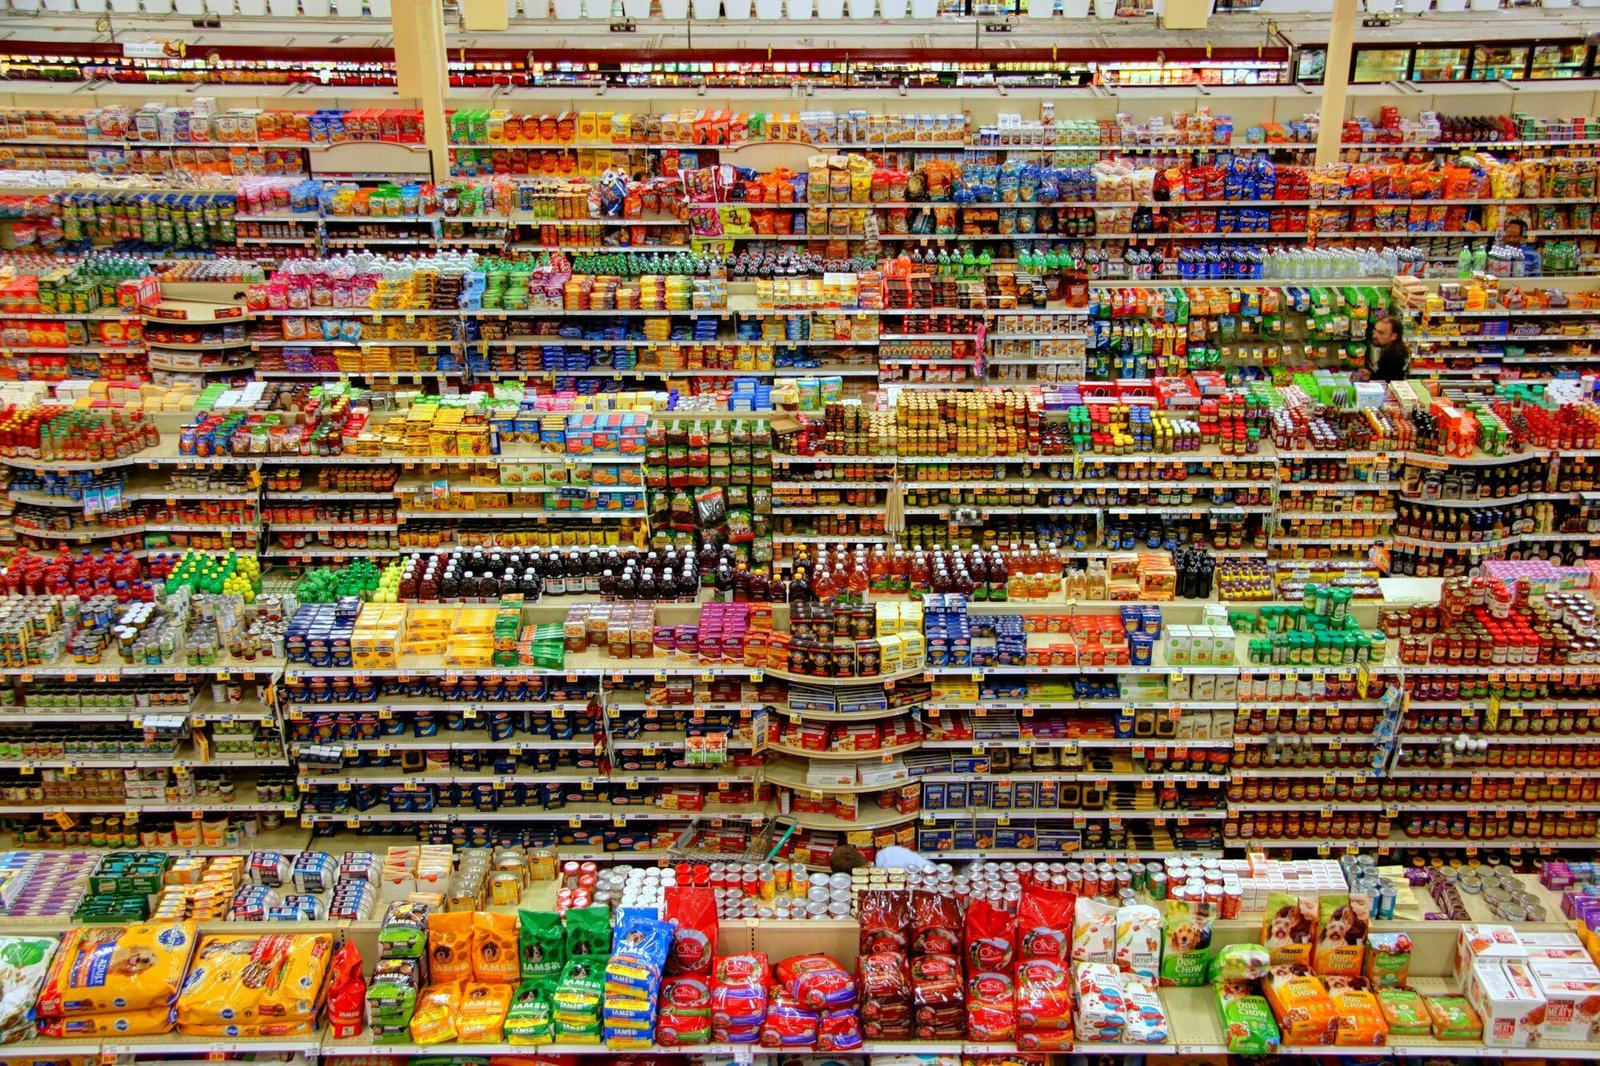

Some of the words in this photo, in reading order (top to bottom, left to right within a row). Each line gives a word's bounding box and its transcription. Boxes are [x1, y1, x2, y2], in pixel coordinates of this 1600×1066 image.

[677, 945, 701, 954] ONE
[872, 943, 895, 953] ONE
[924, 941, 947, 951] ONE
[1033, 940, 1058, 951] ONE
[523, 962, 551, 971] IAMS
[921, 963, 945, 971] ONE
[1176, 958, 1195, 967] DOG
[1328, 961, 1354, 969] CHOW
[94, 957, 108, 984] ADULT
[433, 964, 459, 973] IAMS
[479, 964, 506, 972] IAMS
[726, 963, 750, 972] ONE
[1175, 965, 1202, 974] CHOW
[563, 979, 591, 987] IAMS
[1289, 983, 1308, 991] DOG
[674, 988, 698, 996] ONE
[1291, 989, 1317, 997] CHOW
[1238, 1002, 1257, 1010] DOG
[1238, 1009, 1267, 1017] CHOW
[1548, 1008, 1572, 1016] MEATY
[1495, 1024, 1514, 1033] MEATY
